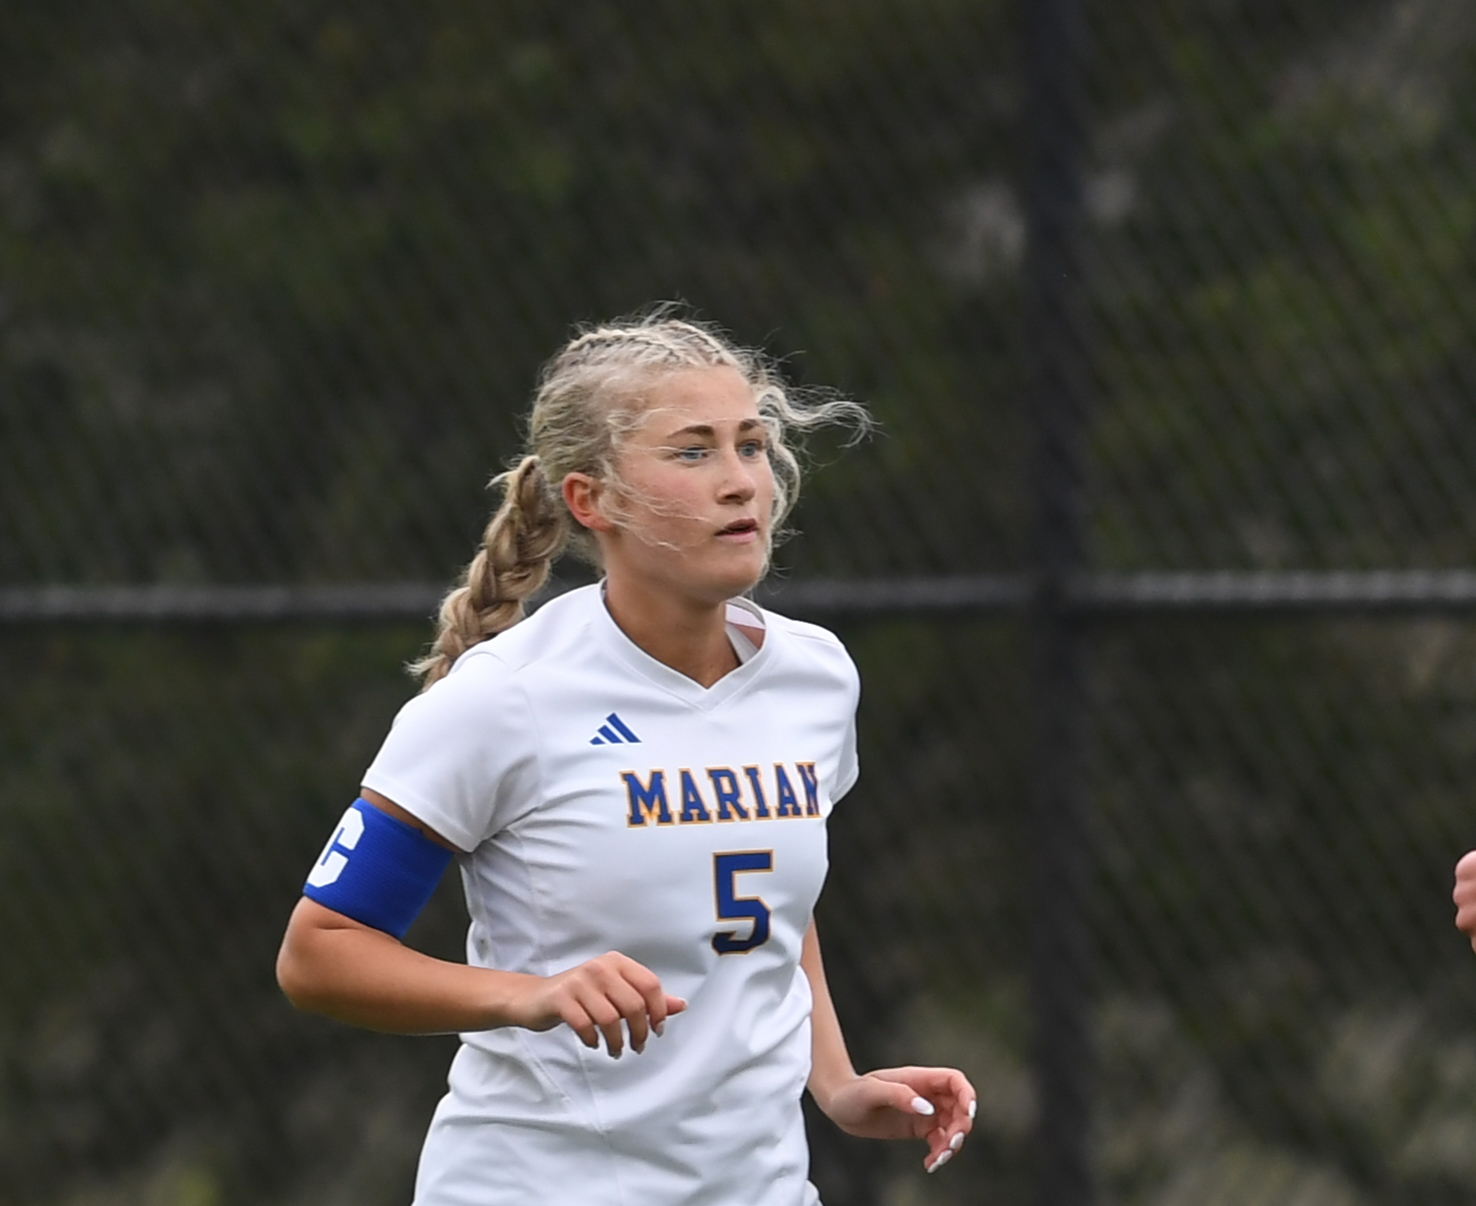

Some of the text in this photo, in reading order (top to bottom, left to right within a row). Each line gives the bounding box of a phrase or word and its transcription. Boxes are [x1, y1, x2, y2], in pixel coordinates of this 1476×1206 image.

[619, 762, 822, 828] MARIAN
[307, 807, 365, 888] C
[711, 849, 774, 956] 5
